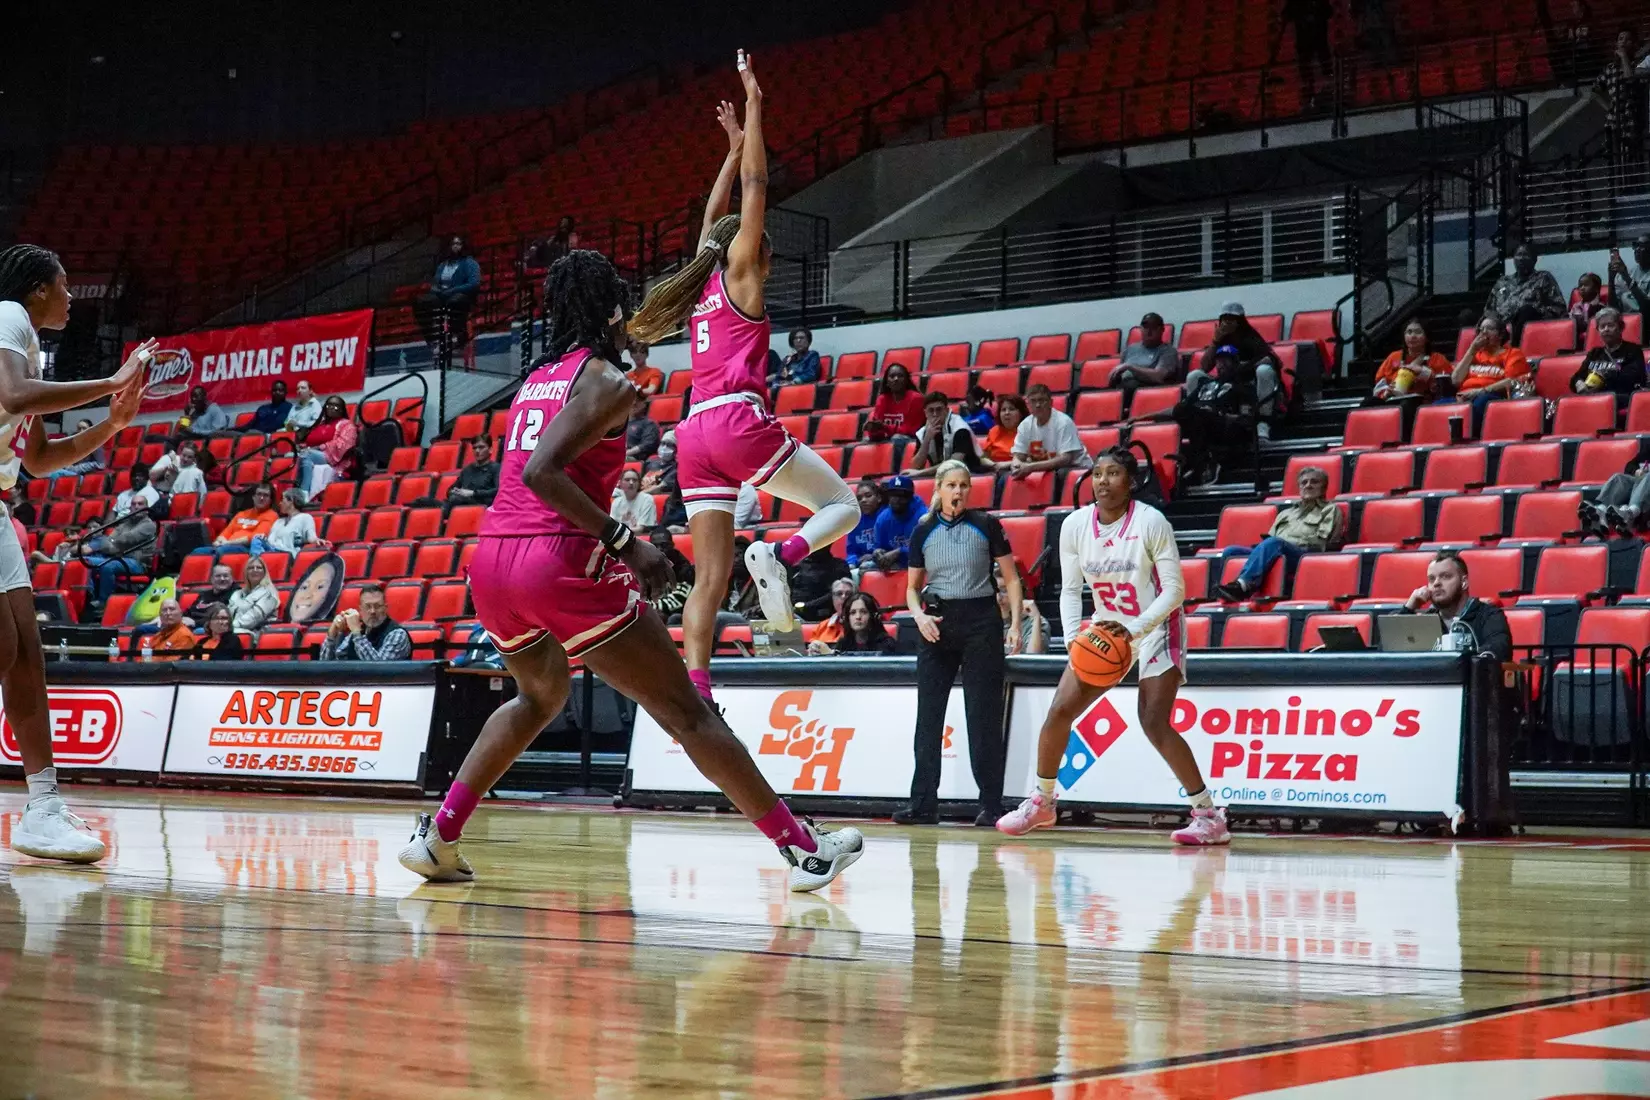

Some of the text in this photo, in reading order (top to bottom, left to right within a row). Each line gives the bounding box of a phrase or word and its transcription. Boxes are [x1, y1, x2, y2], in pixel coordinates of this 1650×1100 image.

[697, 319, 711, 354] 5
[201, 336, 359, 383] CANIAC CREW
[507, 408, 544, 451] 12
[1093, 582, 1140, 617] 23
[219, 689, 382, 728] ARTECH
[1168, 696, 1421, 738] Domino's
[211, 731, 256, 743] SIGNS
[258, 732, 269, 743] &
[349, 734, 379, 748] INC.
[224, 753, 358, 773] 936.435.9966
[1210, 739, 1358, 781] Pizza
[1221, 786, 1267, 801] Online
[1271, 788, 1284, 802] @
[1287, 788, 1387, 804] Dominos.com
